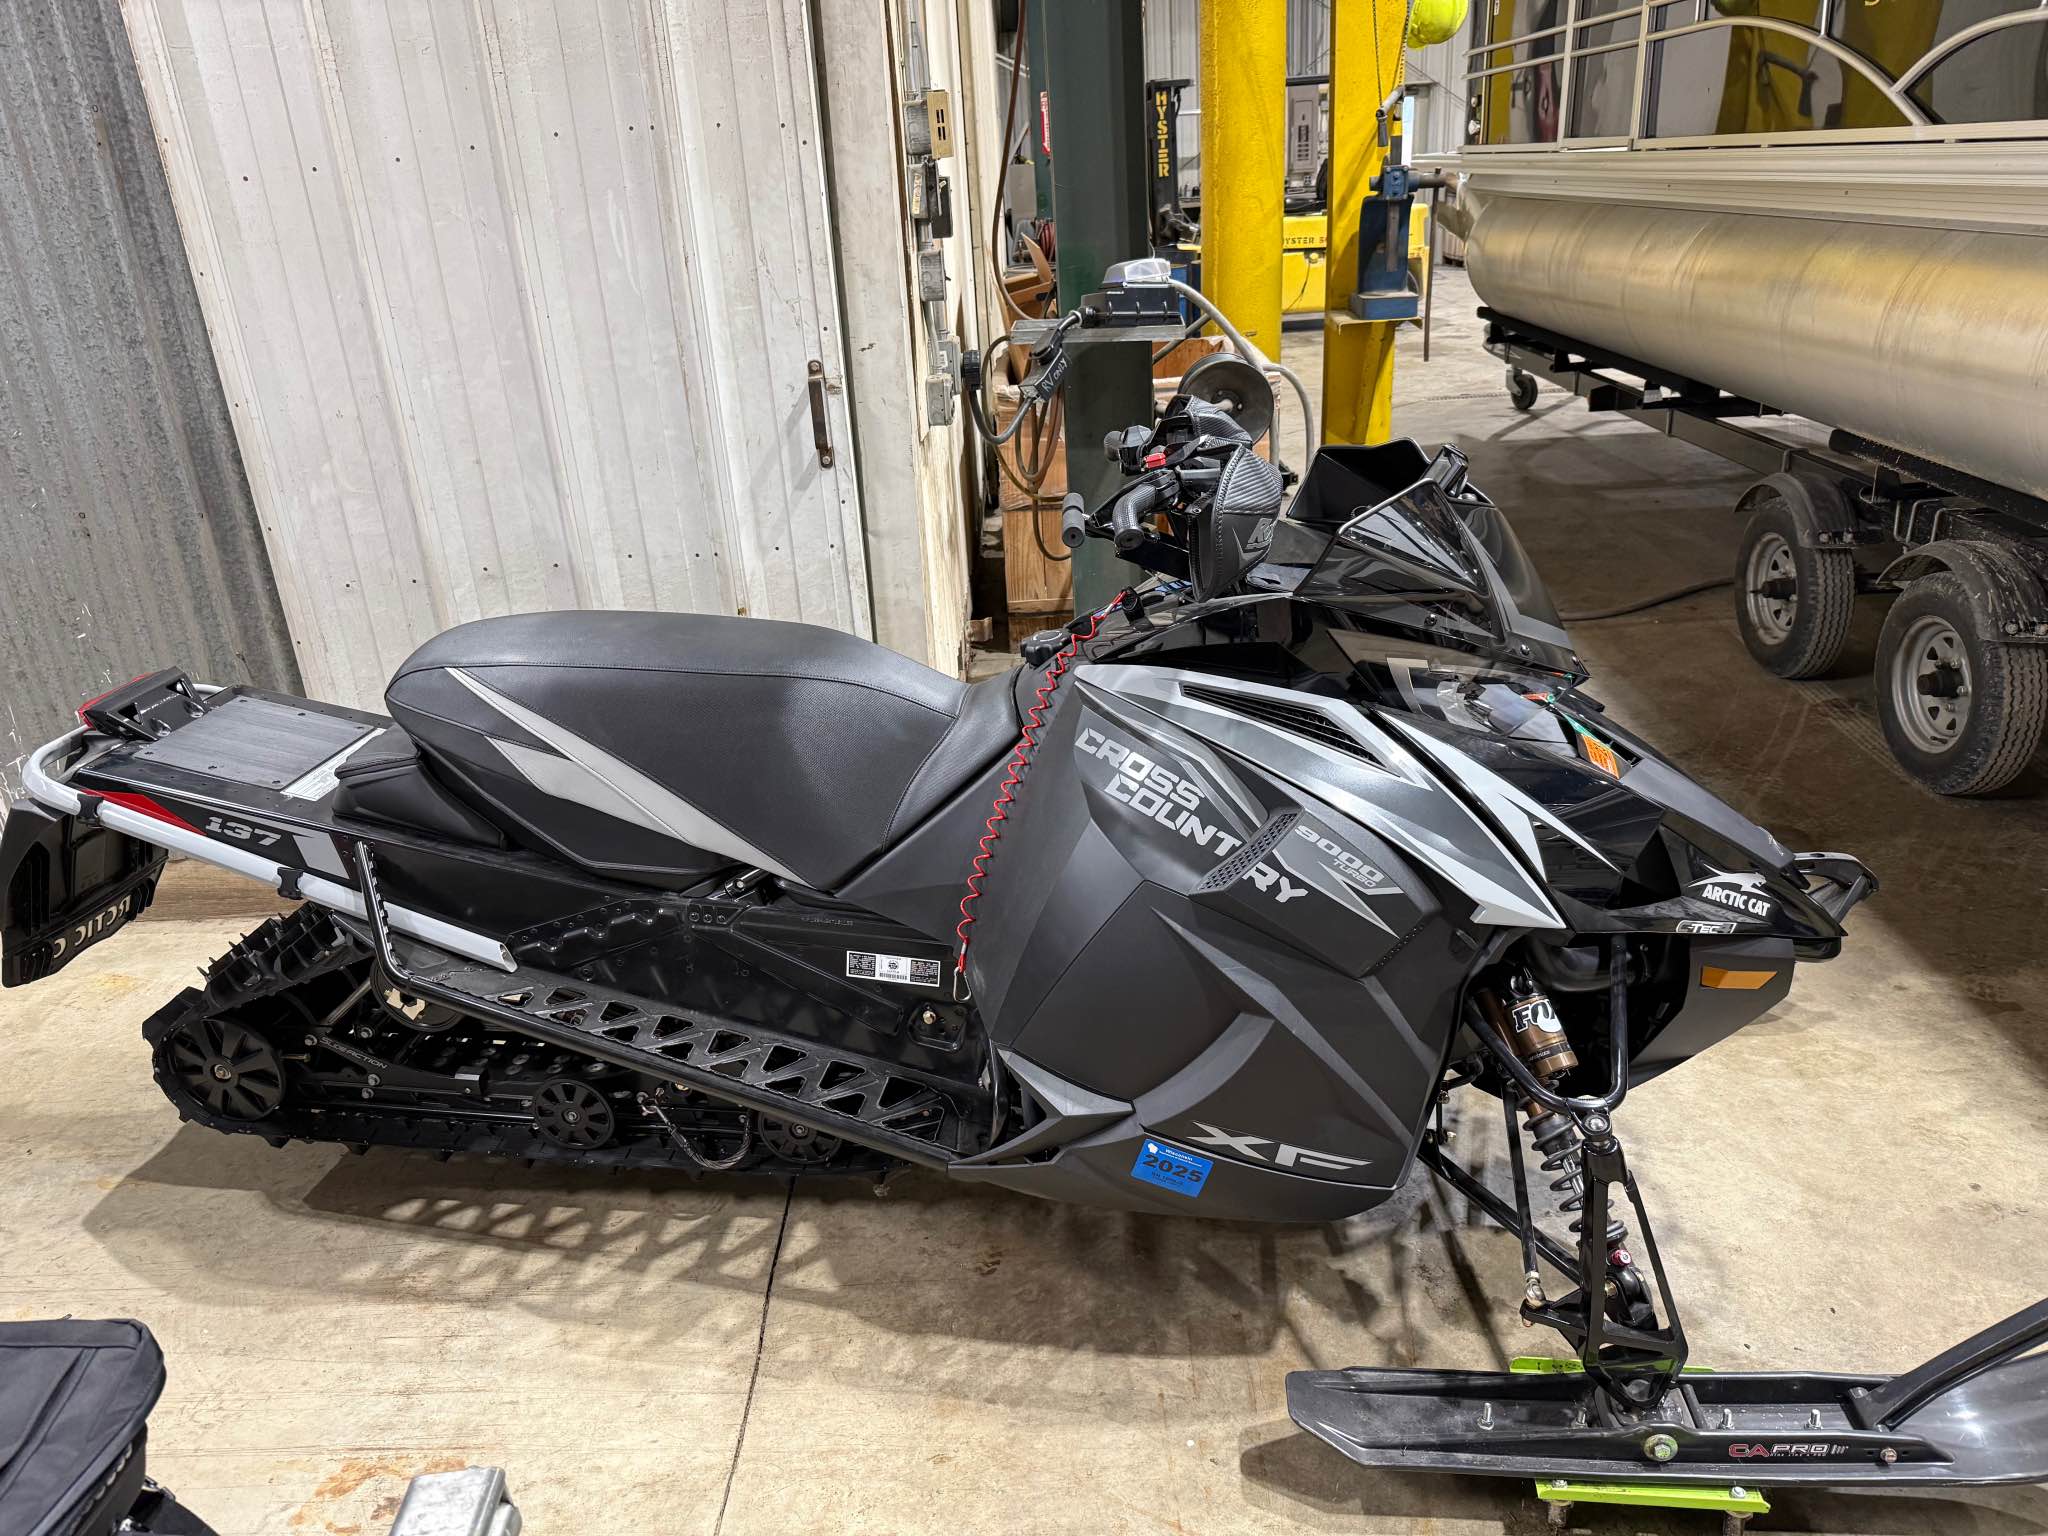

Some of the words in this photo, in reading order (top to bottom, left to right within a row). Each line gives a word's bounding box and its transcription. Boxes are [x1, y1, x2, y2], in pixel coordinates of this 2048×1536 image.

[1156, 91, 1169, 177] HYSTER
[1041, 373, 1055, 393] RV
[1074, 728, 1206, 811] CROSS
[206, 816, 282, 846] 137
[1294, 825, 1385, 883] 9000
[1333, 858, 1377, 888] TURBO
[1701, 883, 1749, 910] ARCTIC
[1747, 898, 1771, 917] CAT
[1186, 1120, 1374, 1171] XF
[1142, 1153, 1204, 1183] 2025
[1771, 1443, 1830, 1454] PRO
